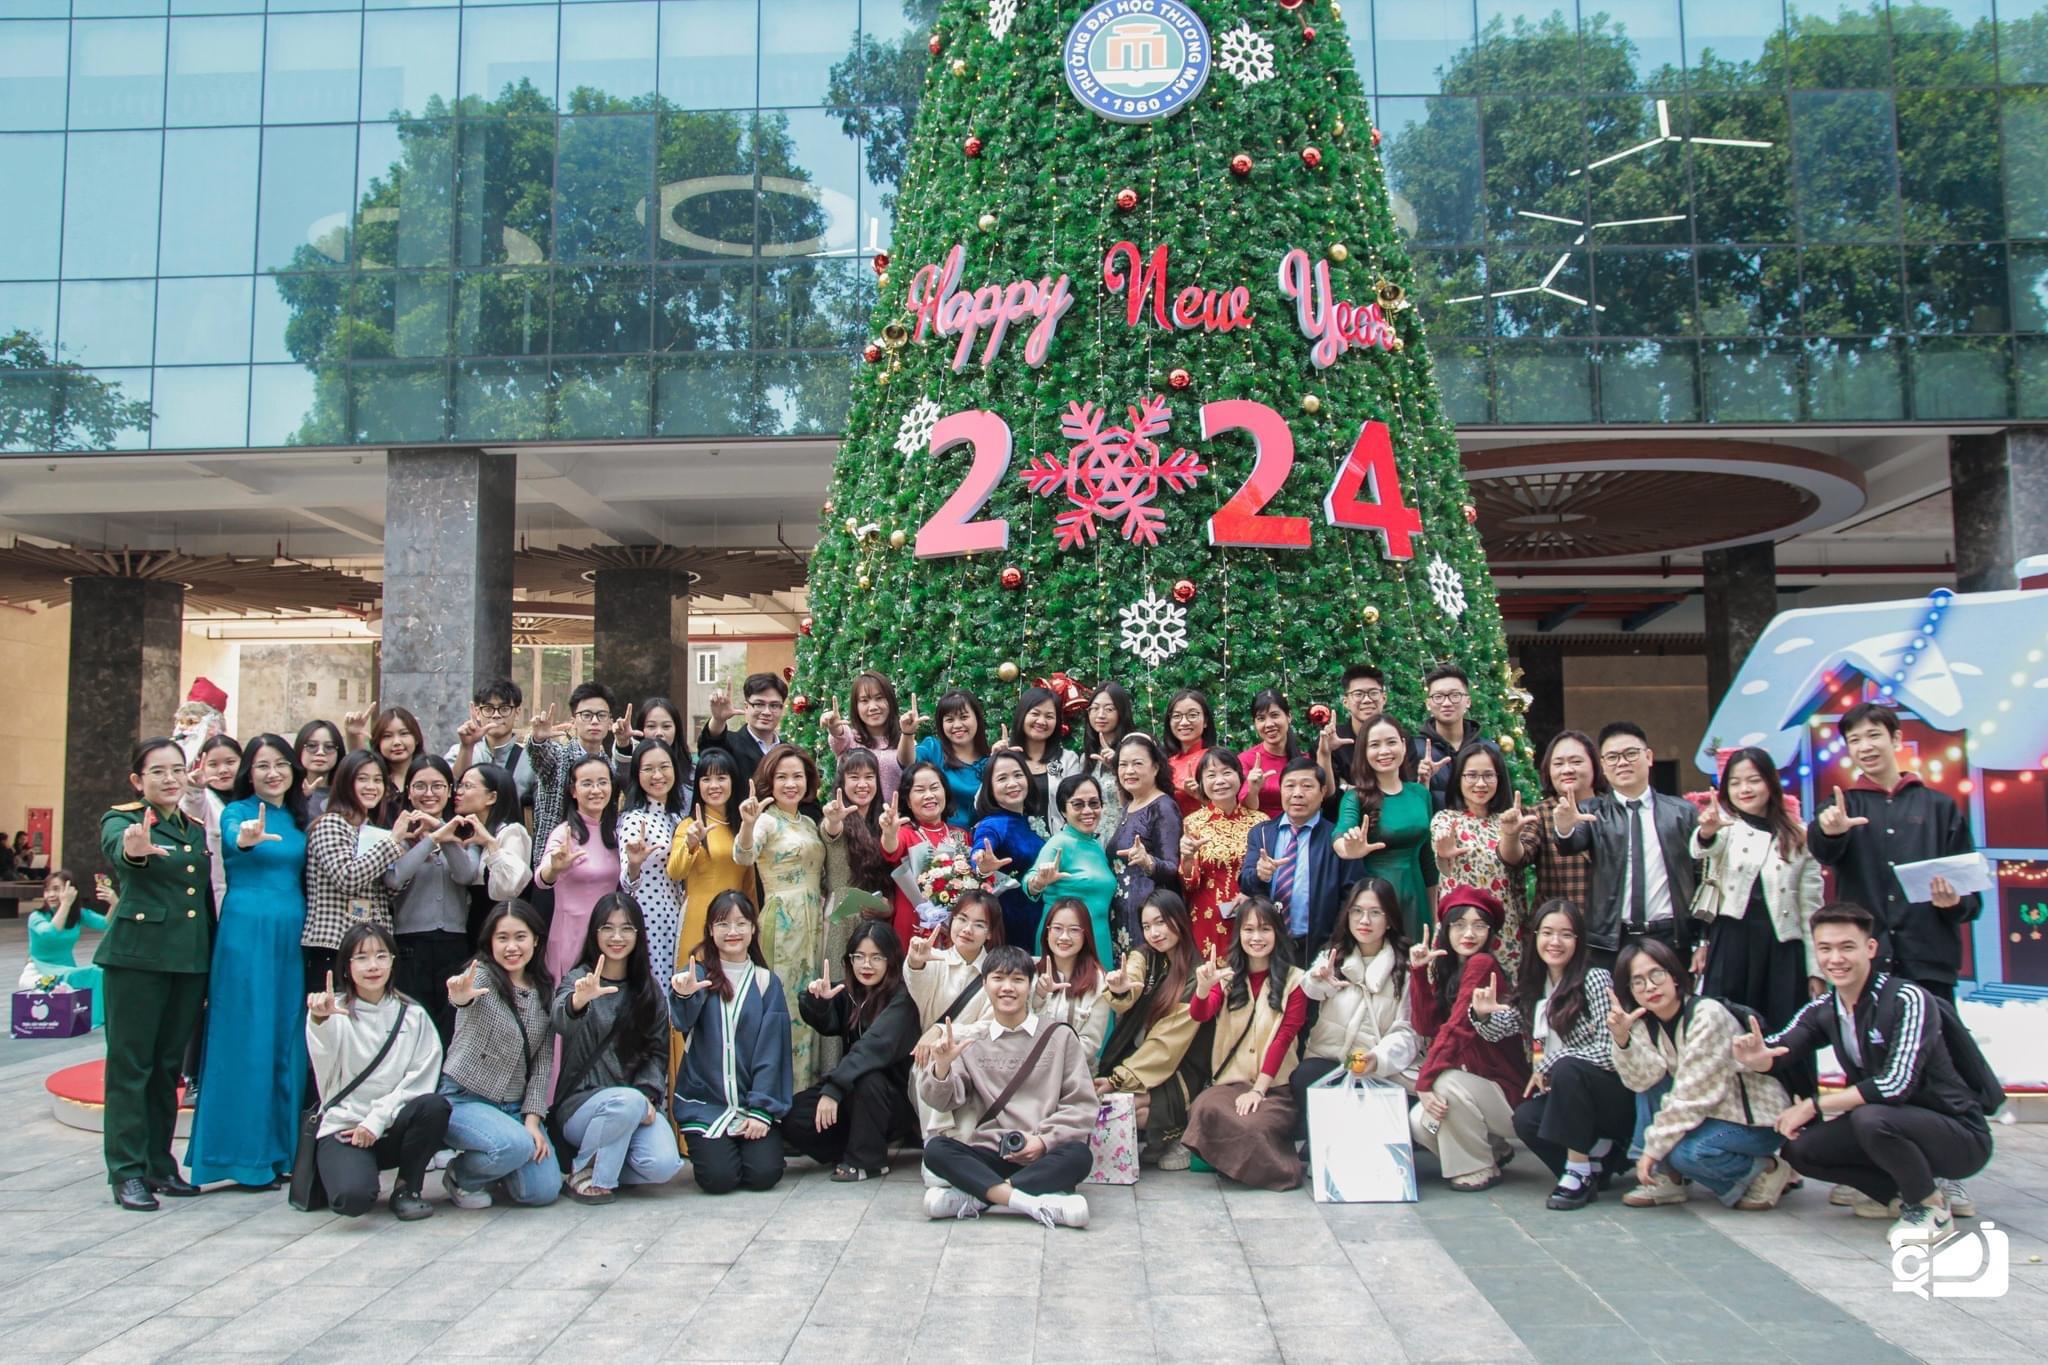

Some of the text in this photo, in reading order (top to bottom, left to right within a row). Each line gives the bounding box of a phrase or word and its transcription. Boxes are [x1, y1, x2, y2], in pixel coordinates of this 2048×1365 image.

[1069, 0, 1201, 98] TRƯỜNG ĐẠI HỌC THƯƠNG MẠI
[1113, 98, 1160, 113] 1960
[907, 241, 1395, 373] Happy New Year
